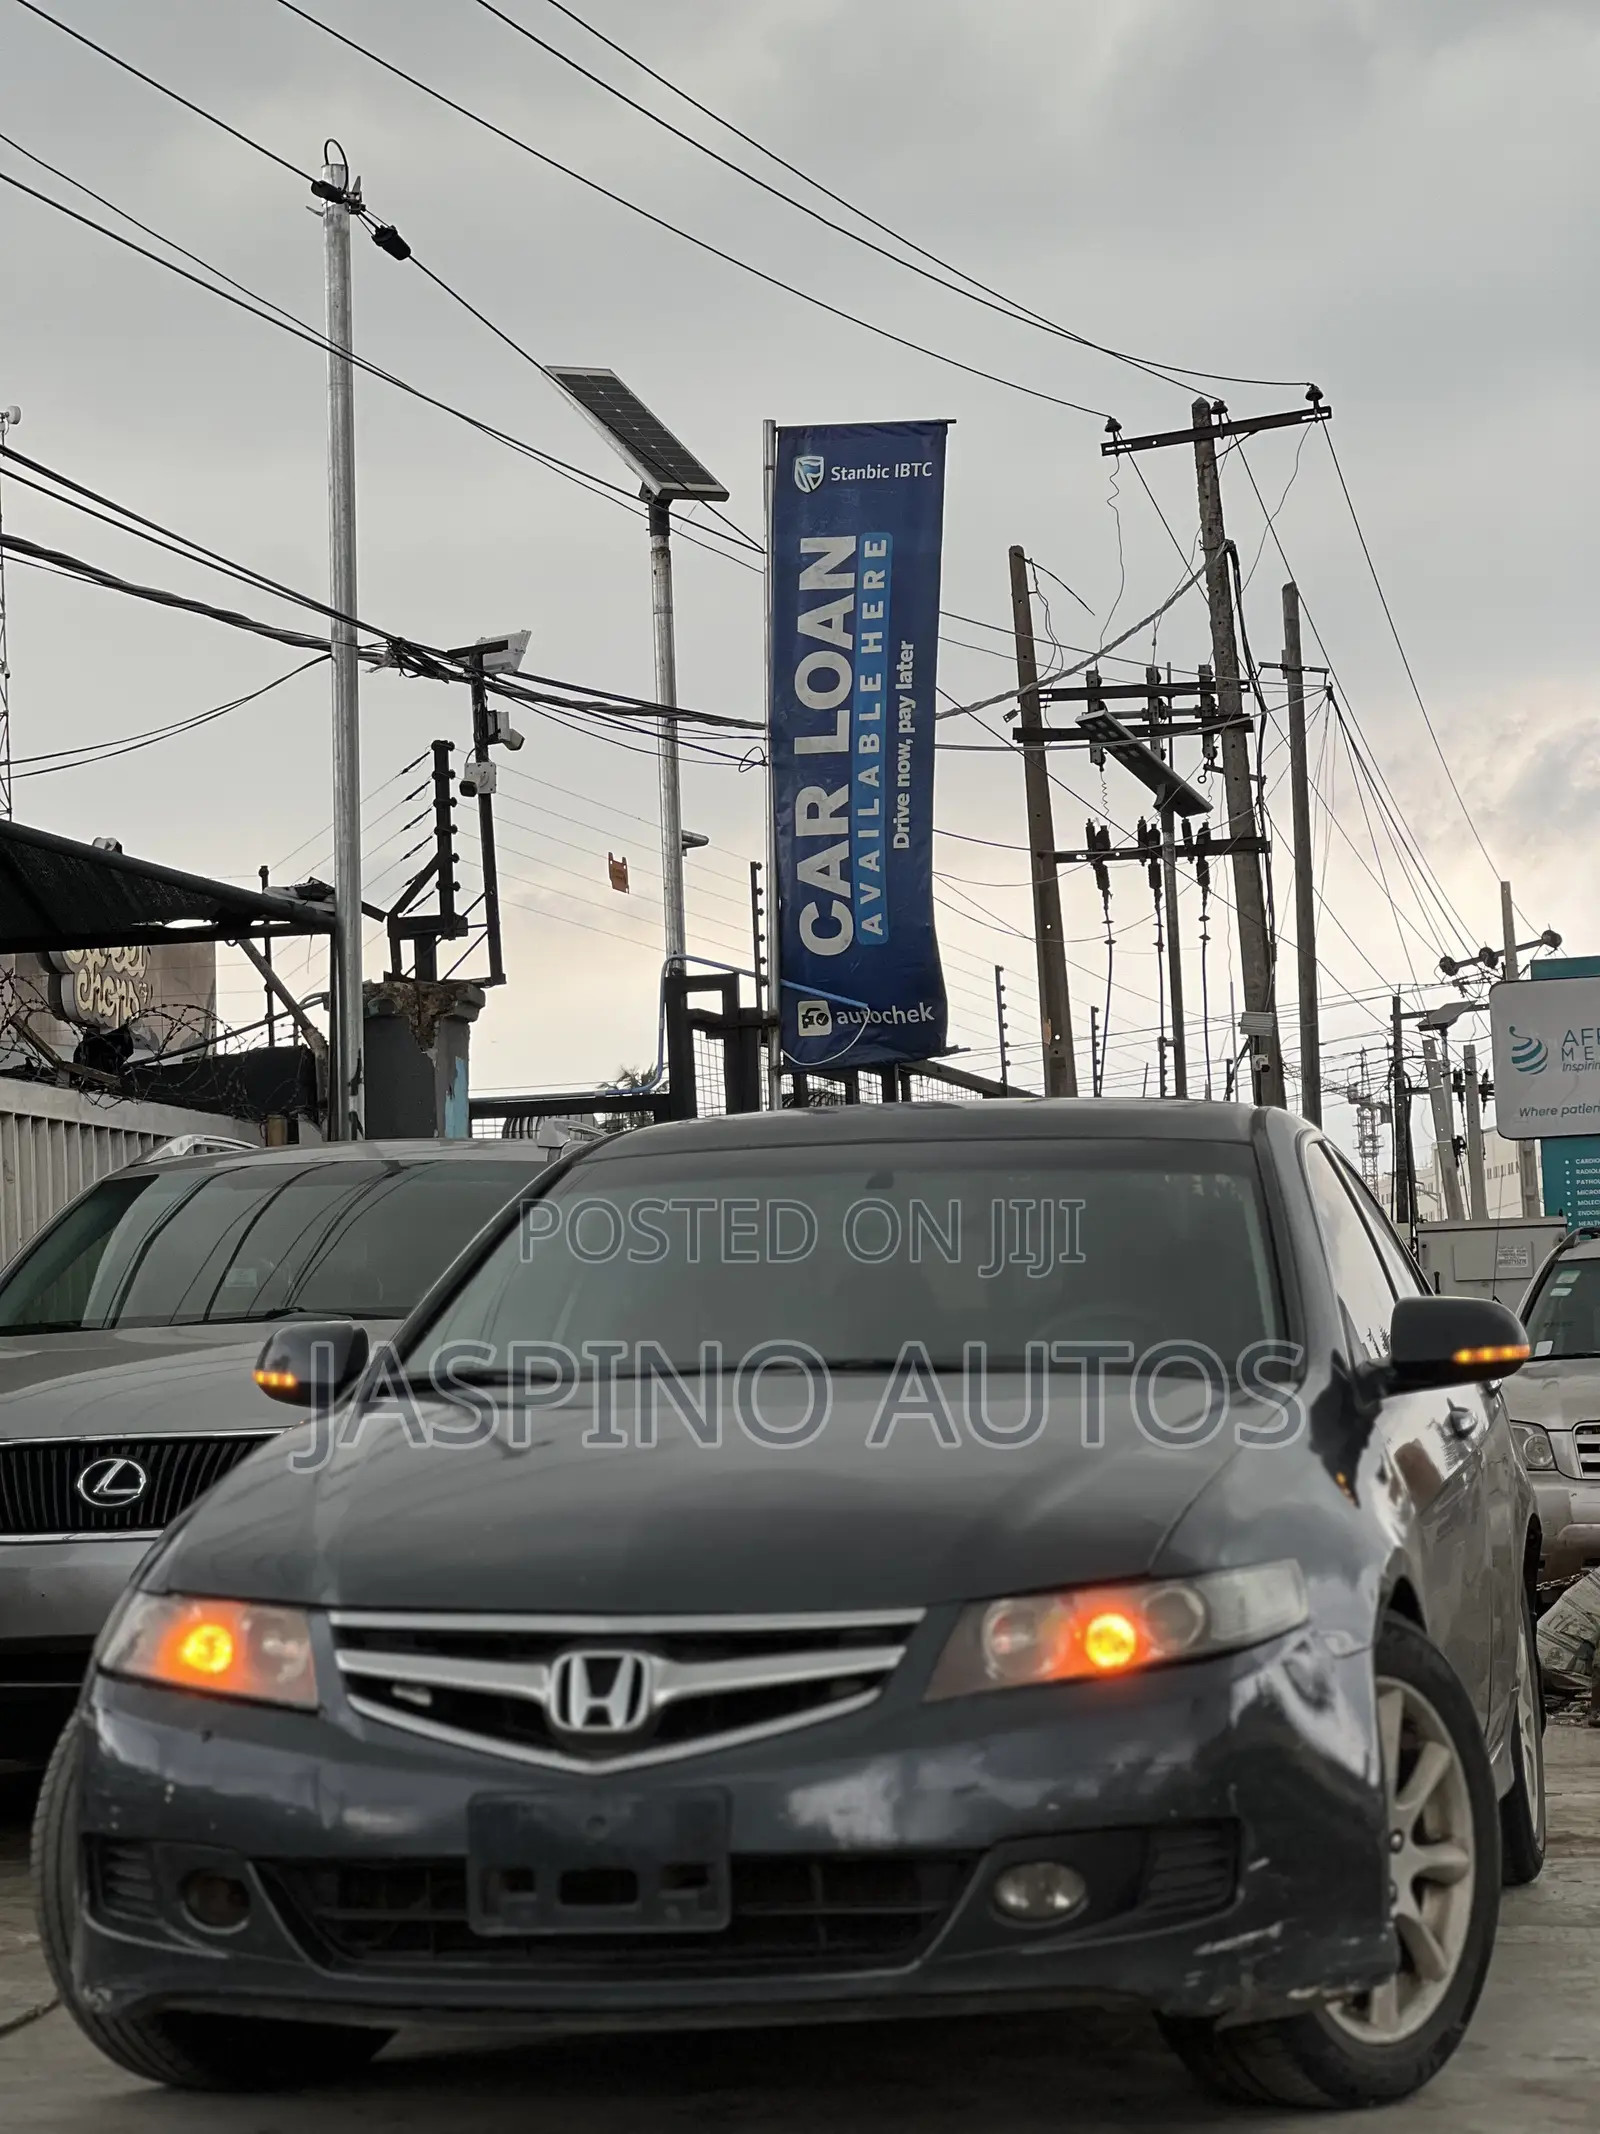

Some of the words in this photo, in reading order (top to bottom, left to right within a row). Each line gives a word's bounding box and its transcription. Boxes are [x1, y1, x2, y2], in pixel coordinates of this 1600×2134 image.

[831, 464, 890, 481] Stanbic
[894, 461, 933, 478] IBTC
[860, 539, 887, 654] HERE
[793, 535, 857, 755] LOAN
[896, 640, 914, 690] later
[898, 695, 916, 734] pay
[897, 738, 914, 787] now,
[857, 672, 884, 936] AVAILABLE
[893, 793, 911, 849] Drive
[795, 783, 855, 957] CAR
[836, 1002, 935, 1025] autochek
[1519, 1106, 1558, 1117] Where
